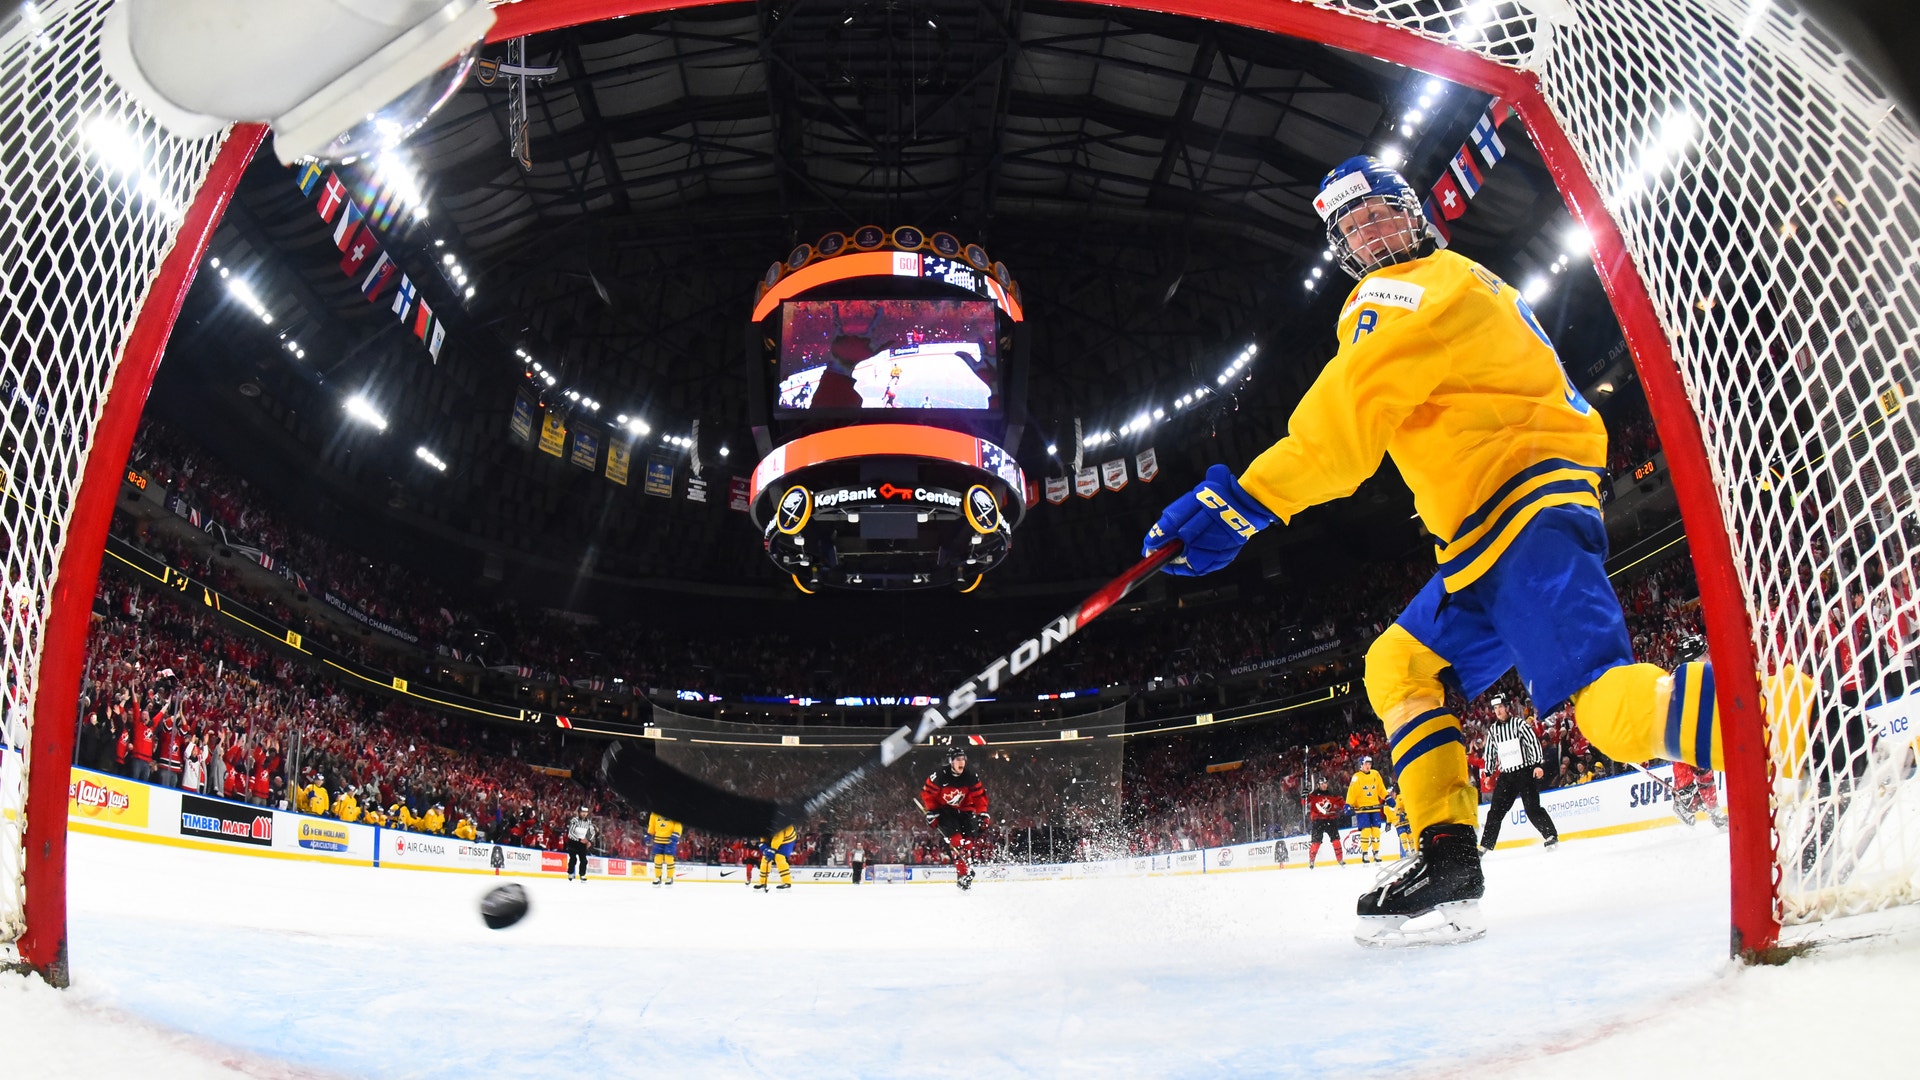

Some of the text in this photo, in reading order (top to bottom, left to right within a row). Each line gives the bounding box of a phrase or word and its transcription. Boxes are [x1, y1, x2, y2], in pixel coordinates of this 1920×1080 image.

[1325, 182, 1366, 210] SVENSKA SPEL
[1394, 294, 1414, 304] SPEL
[1587, 340, 1627, 377] TED DAR
[1635, 461, 1654, 480] 10:20
[128, 471, 147, 490] 10:20
[814, 486, 962, 508] KeyBank Center
[325, 592, 419, 643] WORLD JUNIOR CHAMPIONSHIP
[1230, 639, 1341, 676] WORLD JUNIOR CHAMPIONSHIP
[880, 614, 1070, 768] EASTON
[1629, 776, 1673, 808] SUPE
[1547, 795, 1600, 813] ORTHOPAEDICS
[182, 812, 250, 838] TIMBER MART
[311, 827, 346, 840] NEW HOLLAND
[309, 840, 339, 851] AGRICULTURE
[407, 842, 418, 852] AIR
[418, 843, 445, 855] CANADA
[468, 846, 489, 857] TISSOT
[1255, 845, 1272, 856] TISSOT
[514, 852, 531, 862] TISSOT
